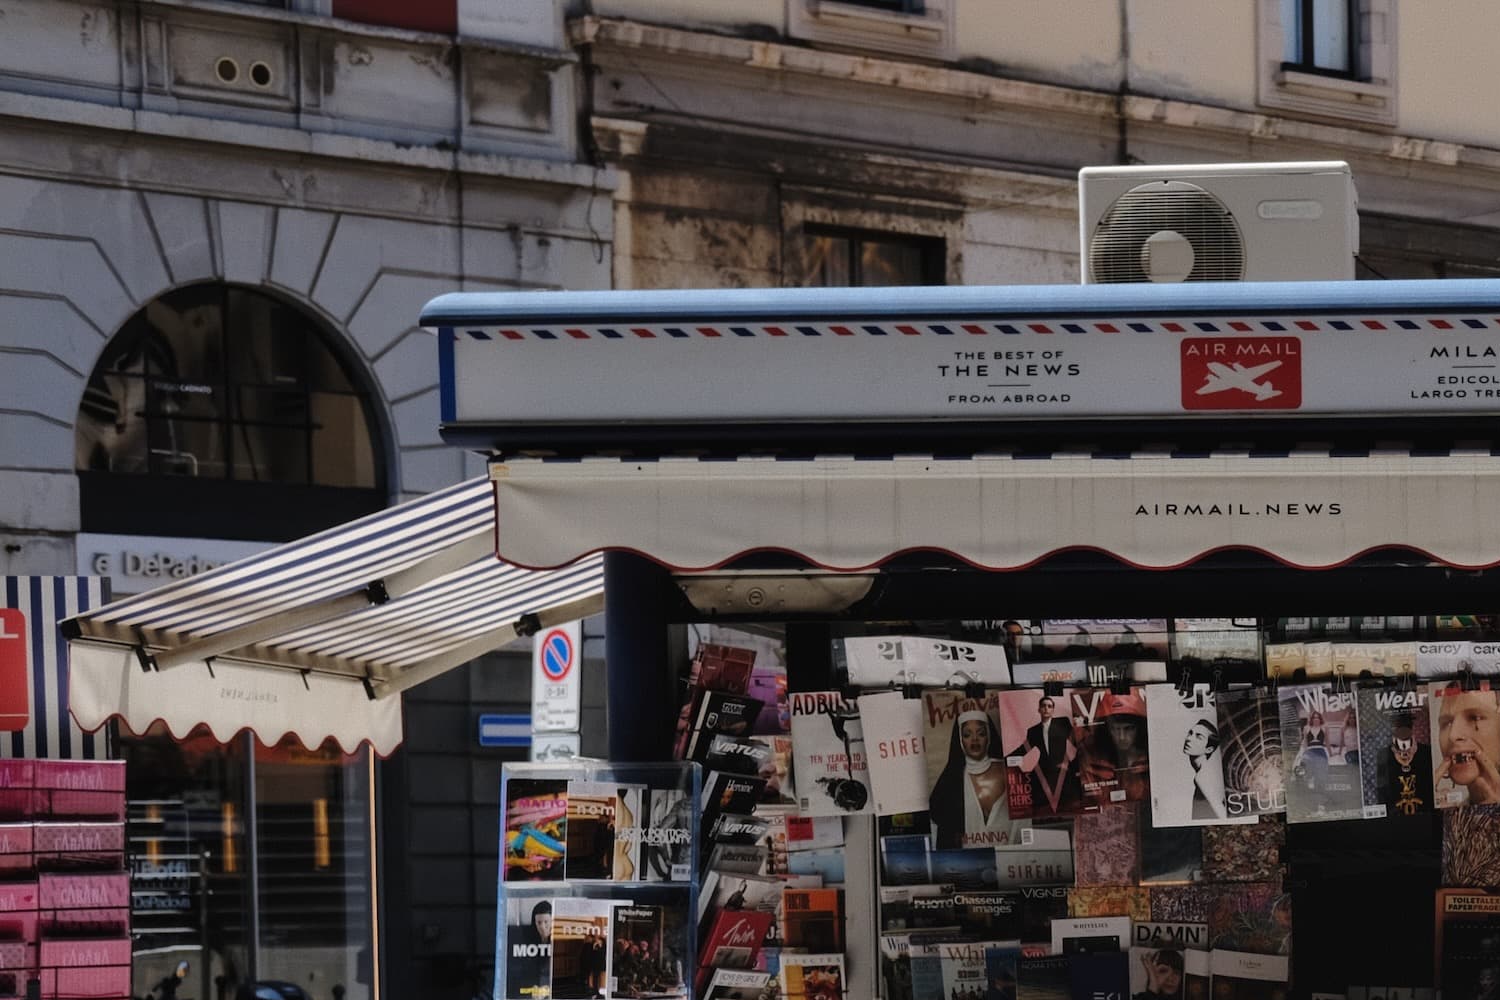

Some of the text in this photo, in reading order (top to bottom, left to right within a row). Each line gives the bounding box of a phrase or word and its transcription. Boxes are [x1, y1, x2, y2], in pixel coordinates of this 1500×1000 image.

[954, 350, 1064, 360] THE BEST OF
[1185, 342, 1297, 356] AIR MAIL
[938, 364, 1081, 377] THE NEWS
[948, 394, 1071, 404] FROM ABROAD
[1411, 389, 1468, 399] LARGO
[1134, 503, 1342, 516] AIRMAIL.NEWS
[1007, 865, 1064, 880] SIRENE
